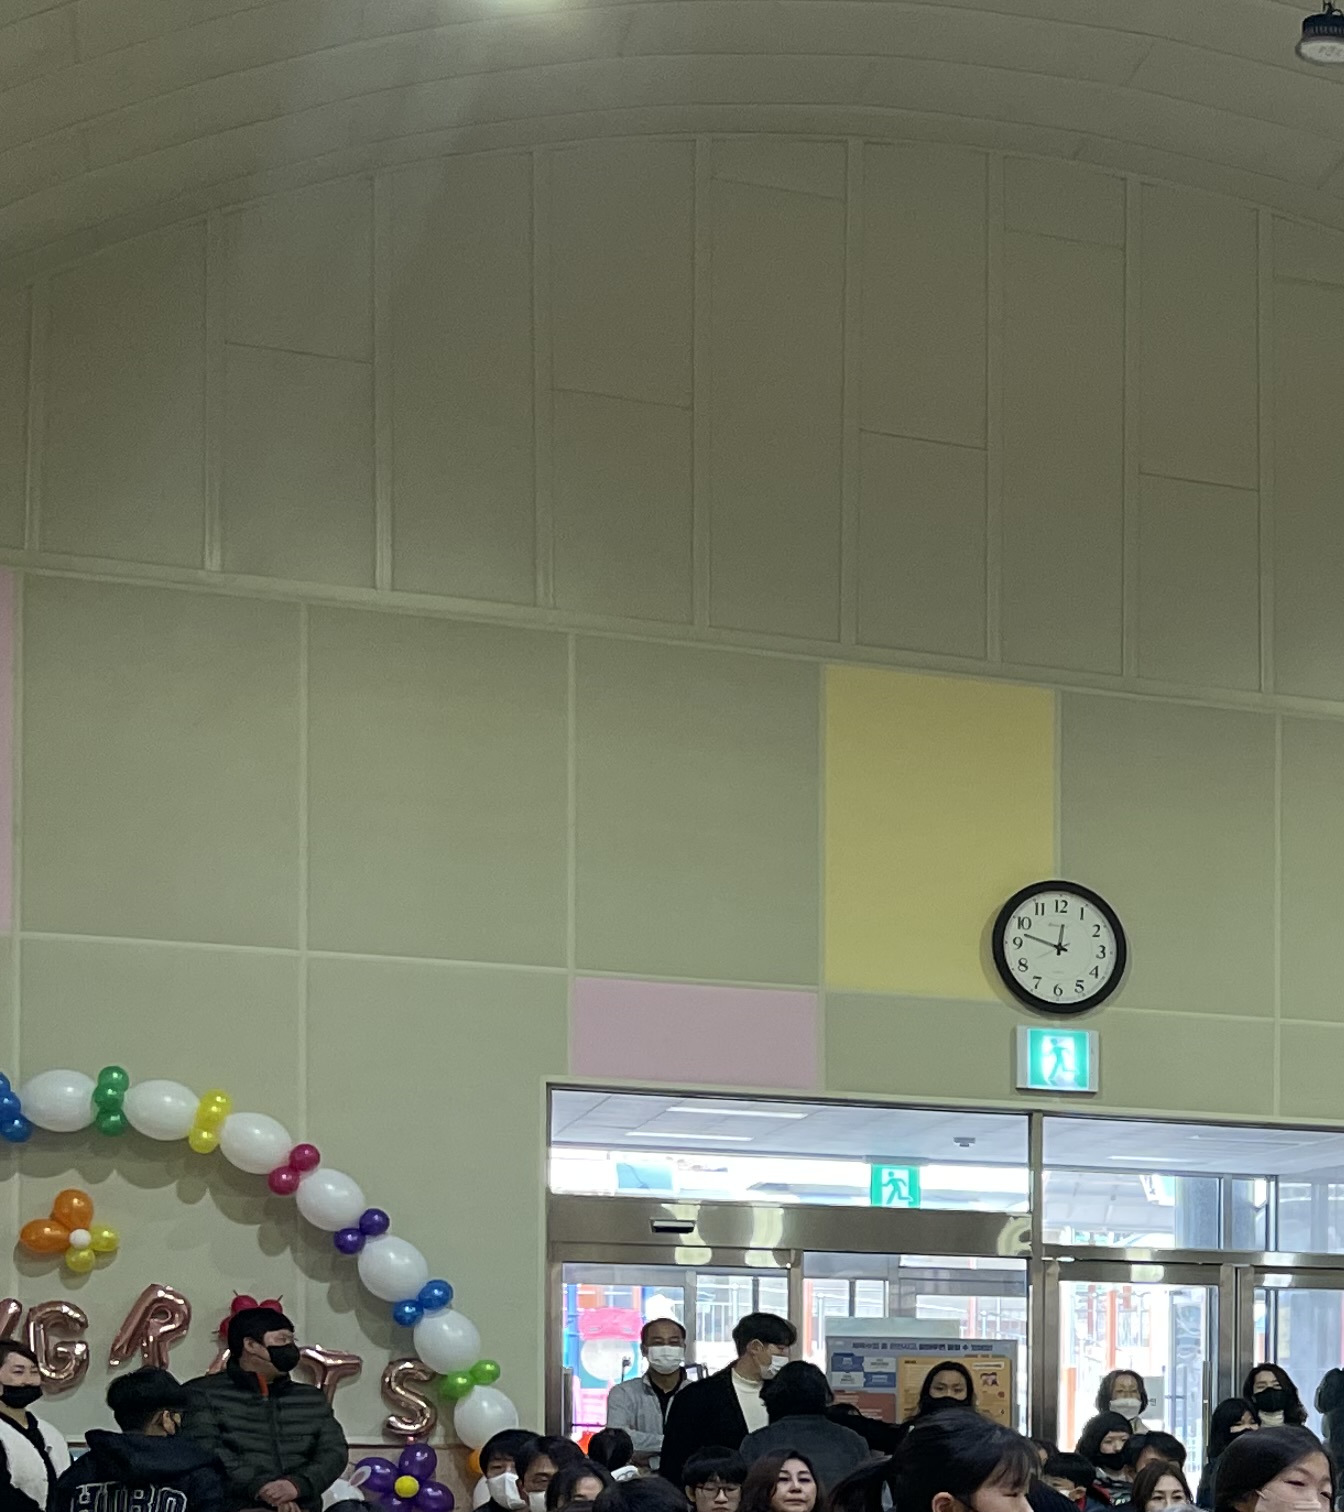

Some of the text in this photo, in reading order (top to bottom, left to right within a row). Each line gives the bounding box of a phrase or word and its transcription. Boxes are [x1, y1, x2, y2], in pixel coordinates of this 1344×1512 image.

[1034, 902, 1045, 916] 11
[1055, 899, 1069, 913] 12
[1080, 906, 1084, 920] 1
[1017, 916, 1032, 930] 10
[1092, 924, 1101, 938] 2
[1012, 936, 1023, 950] 9
[1096, 945, 1106, 959] 3
[1017, 957, 1028, 972] 8
[1089, 965, 1099, 979] 4
[1032, 975, 1042, 989] 7
[1074, 979, 1084, 993] 5
[1053, 983, 1063, 996] 6
[0, 1284, 438, 1440] GRTS
